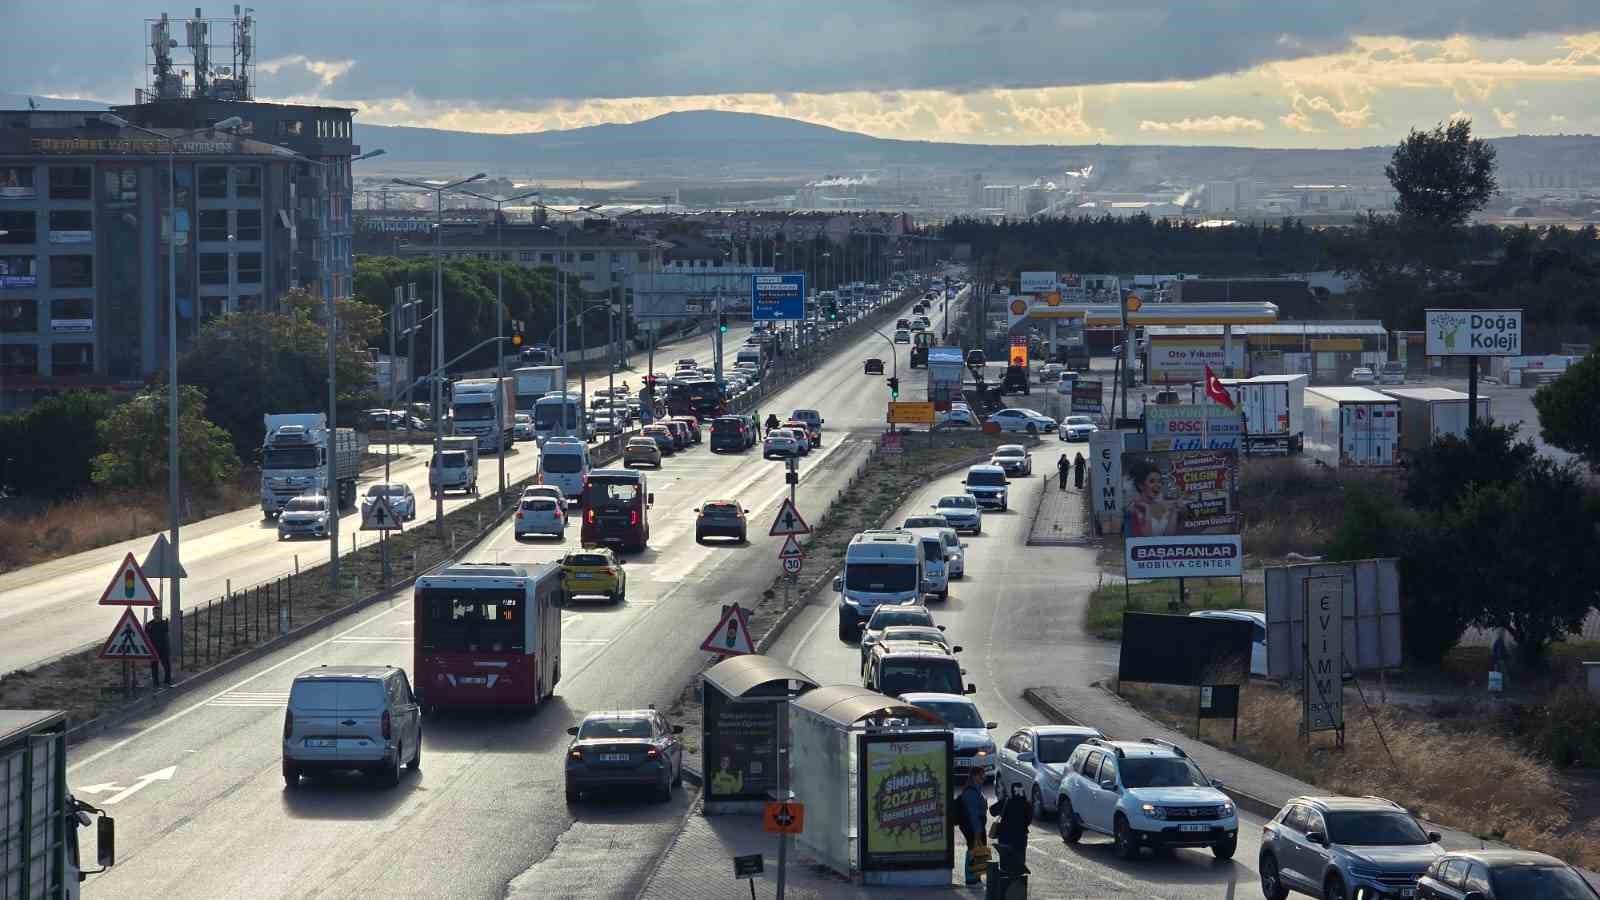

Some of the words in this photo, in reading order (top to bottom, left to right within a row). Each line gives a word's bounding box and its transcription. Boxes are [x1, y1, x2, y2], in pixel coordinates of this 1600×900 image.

[1470, 315, 1517, 333] Doğa
[1470, 333, 1517, 351] Koleji
[1137, 546, 1232, 560] BAŞARANLAR
[787, 560, 799, 569] 30
[1137, 559, 1185, 569] MOBİLYA
[1188, 559, 1232, 569] CENTER
